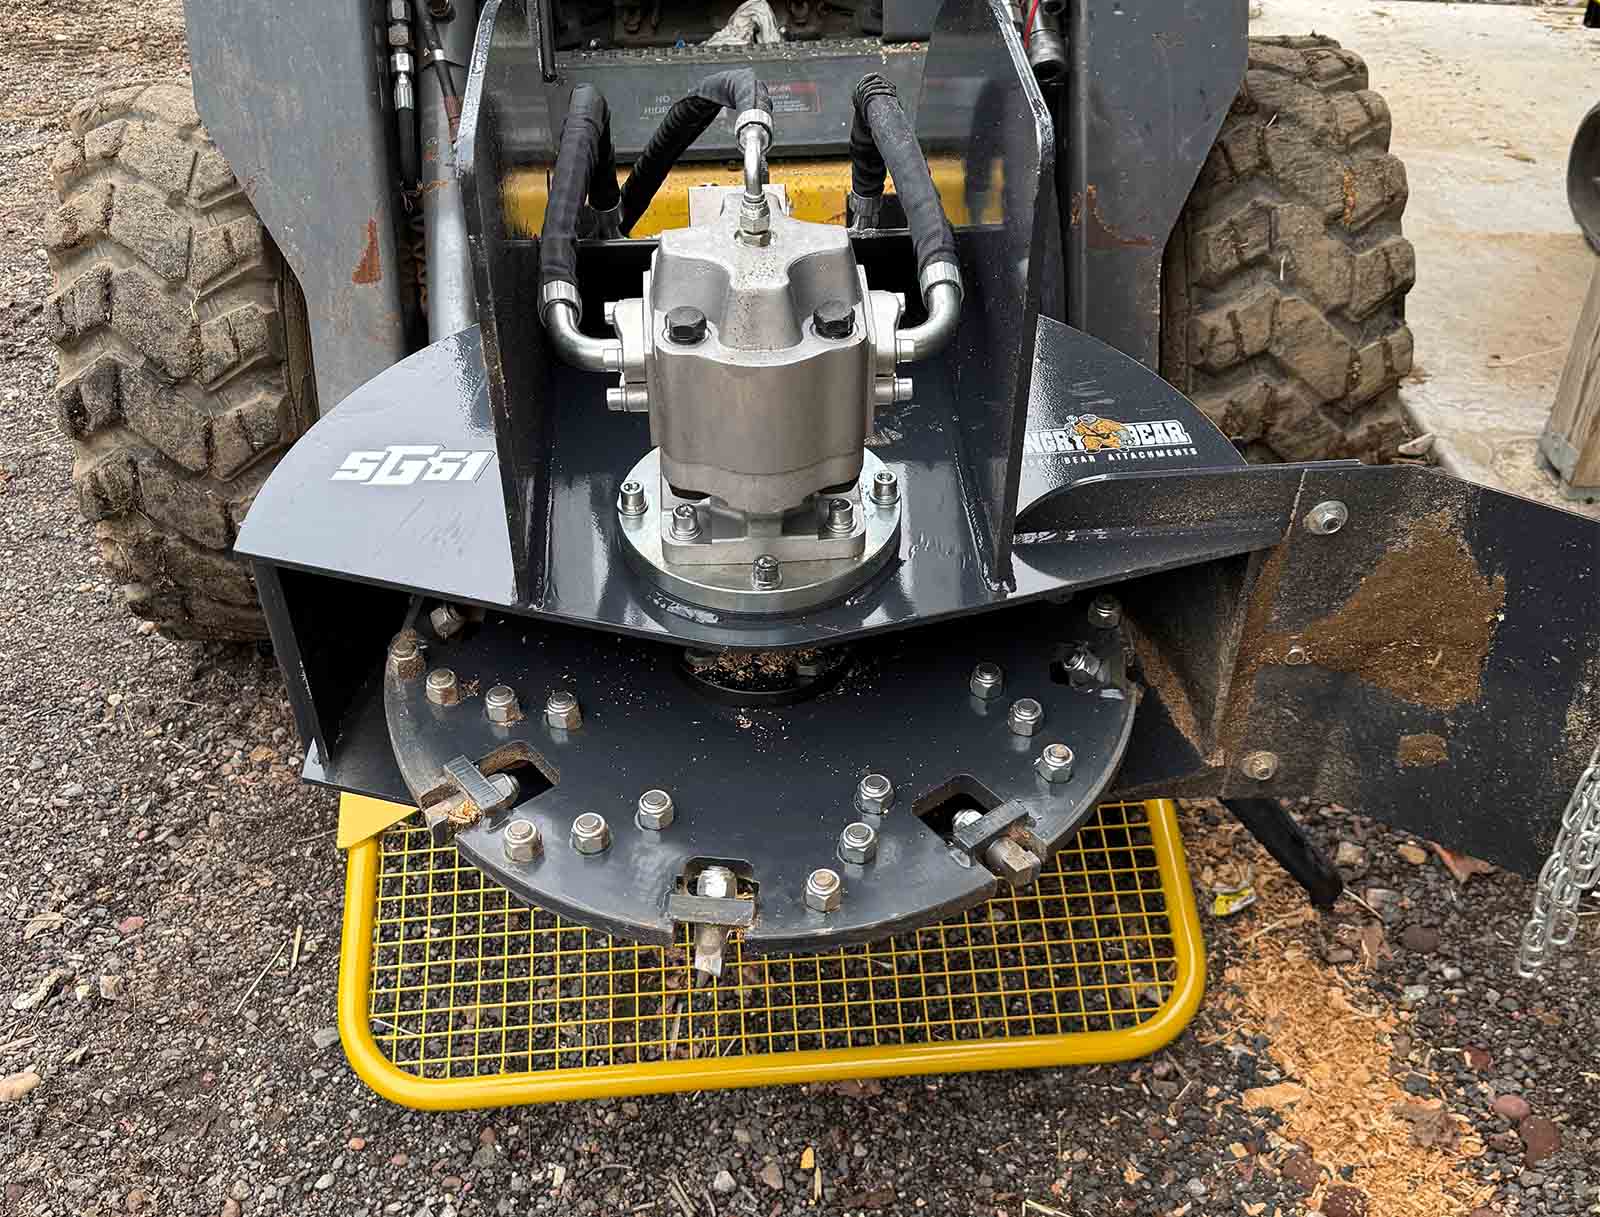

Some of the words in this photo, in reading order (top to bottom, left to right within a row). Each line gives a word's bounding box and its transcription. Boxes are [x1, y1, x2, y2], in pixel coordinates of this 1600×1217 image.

[1023, 430, 1086, 453] NGRY
[1126, 422, 1189, 445] BEAR
[329, 444, 493, 485] SG61
[1063, 455, 1096, 465] BEAR
[1107, 447, 1198, 461] ATTACHMENTS
